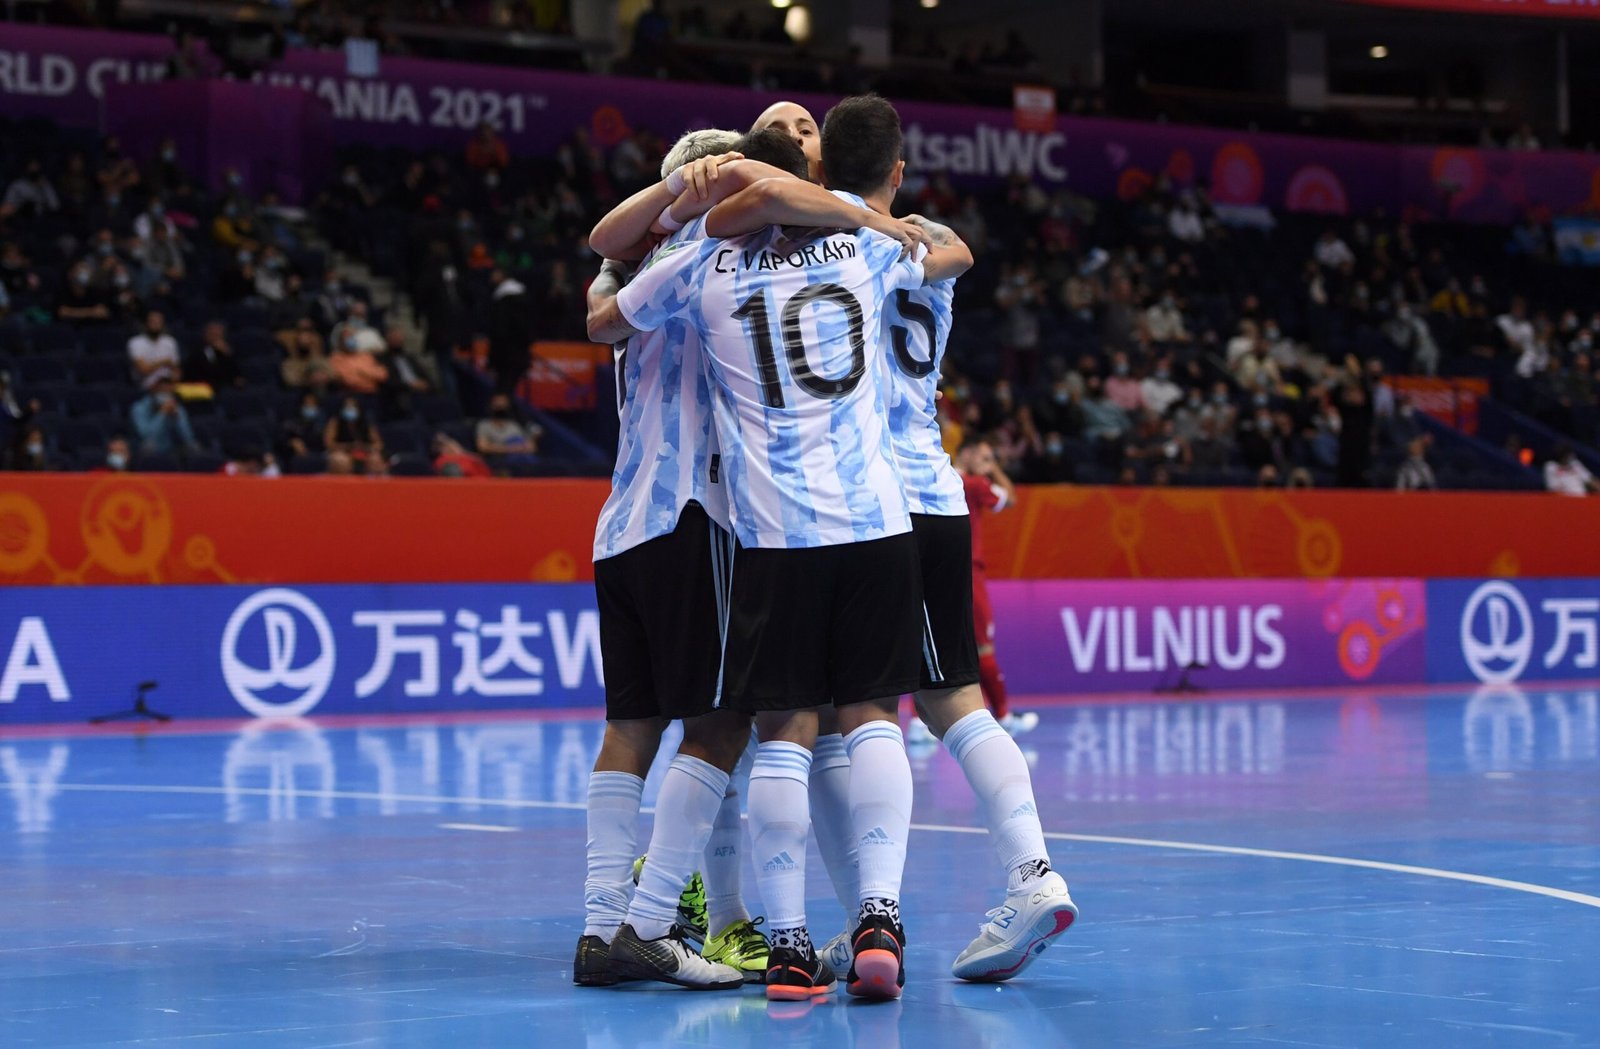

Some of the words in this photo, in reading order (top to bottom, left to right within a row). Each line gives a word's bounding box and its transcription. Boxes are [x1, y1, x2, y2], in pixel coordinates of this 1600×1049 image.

[904, 122, 1068, 181] tsalWC
[714, 249, 736, 273] C.
[730, 283, 864, 409] 10
[547, 610, 608, 689] W
[1061, 605, 1286, 672] VILNIUS
[714, 845, 737, 857] AFA
